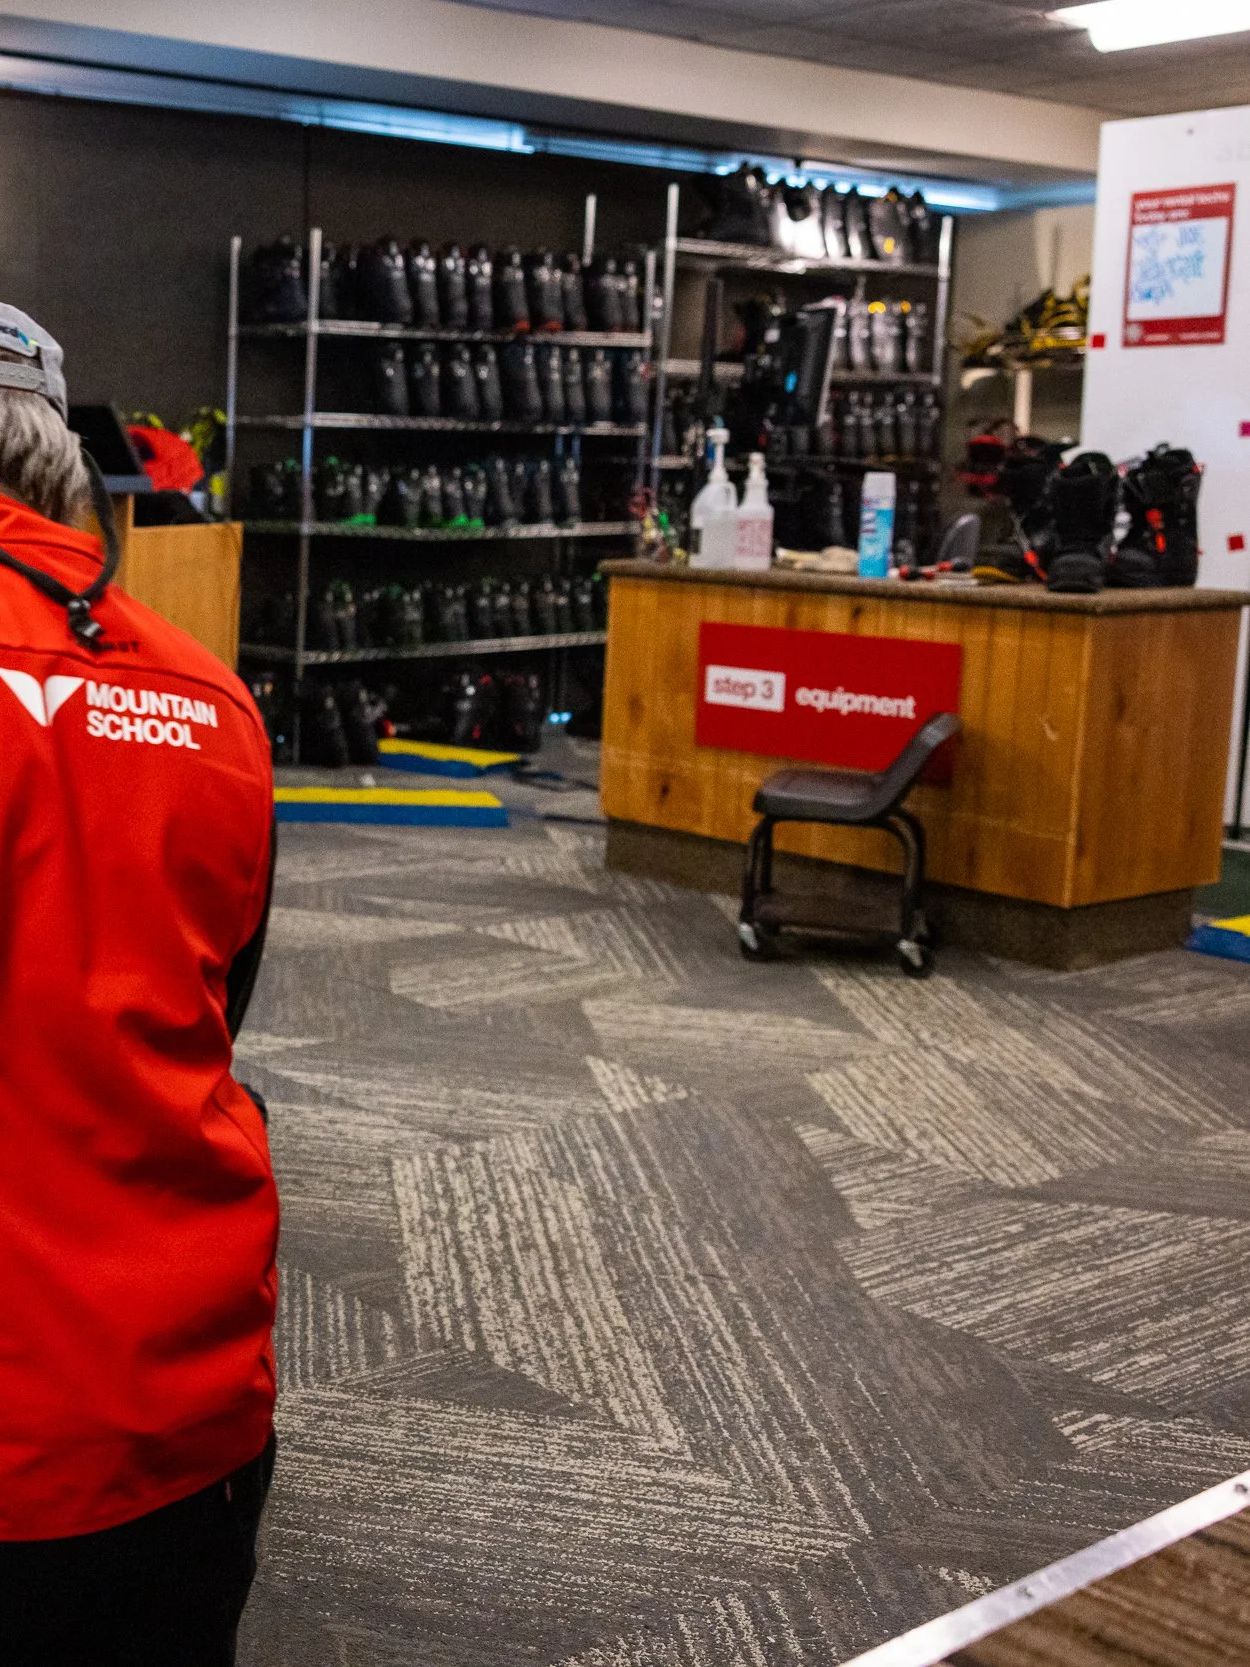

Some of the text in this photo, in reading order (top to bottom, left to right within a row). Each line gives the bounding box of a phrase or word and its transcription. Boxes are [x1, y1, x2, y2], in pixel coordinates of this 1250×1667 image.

[85, 680, 219, 728] MOUNTAIN
[713, 676, 916, 719] step 3 equipment
[86, 710, 201, 750] SCHOOL
